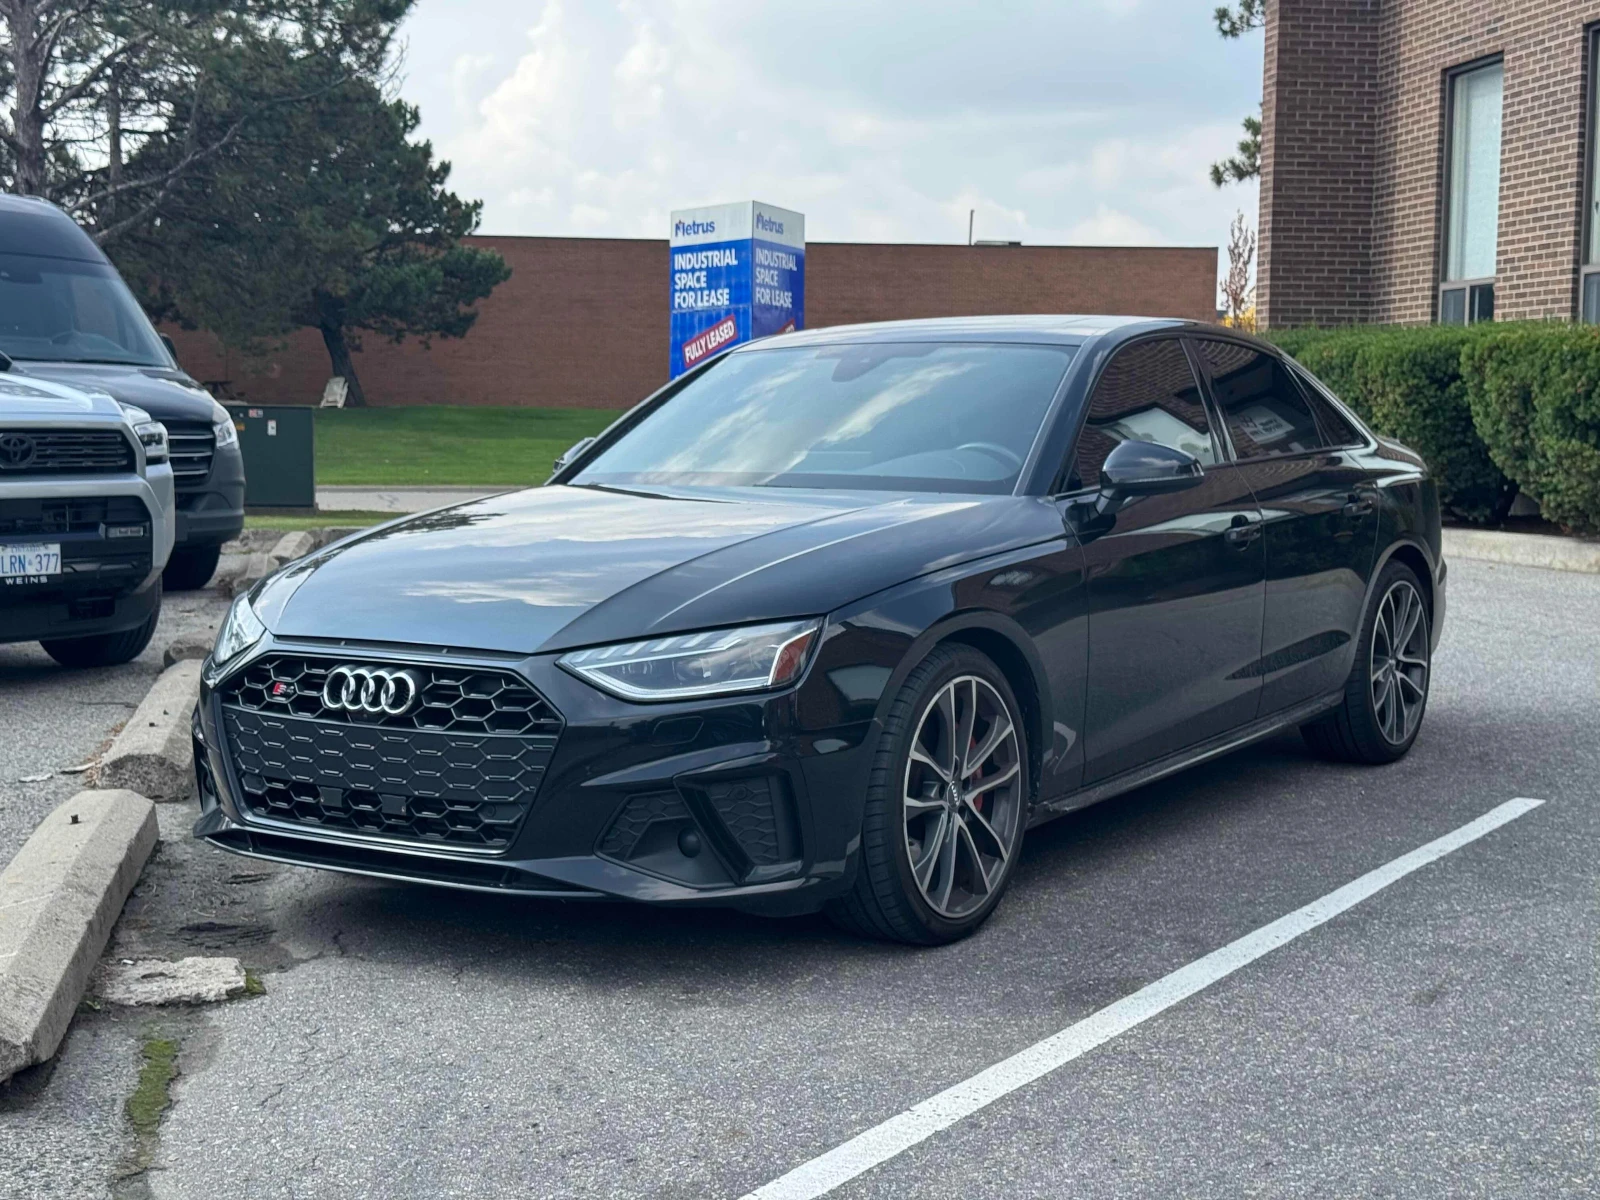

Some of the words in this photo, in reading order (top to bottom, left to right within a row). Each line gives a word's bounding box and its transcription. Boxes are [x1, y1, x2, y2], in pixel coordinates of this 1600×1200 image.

[675, 220, 715, 237] Metrus
[674, 248, 738, 270] INDUSTRIAL
[756, 249, 797, 271] INDUSTRIAL
[674, 271, 707, 290] SPACE
[756, 268, 778, 286] SPACE
[674, 291, 695, 308] FOR
[697, 288, 730, 307] LEASE
[756, 288, 771, 304] FOR
[772, 291, 792, 308] LEASE
[684, 337, 706, 363] FULLY
[706, 320, 734, 349] LEASED
[35, 553, 59, 572] 377
